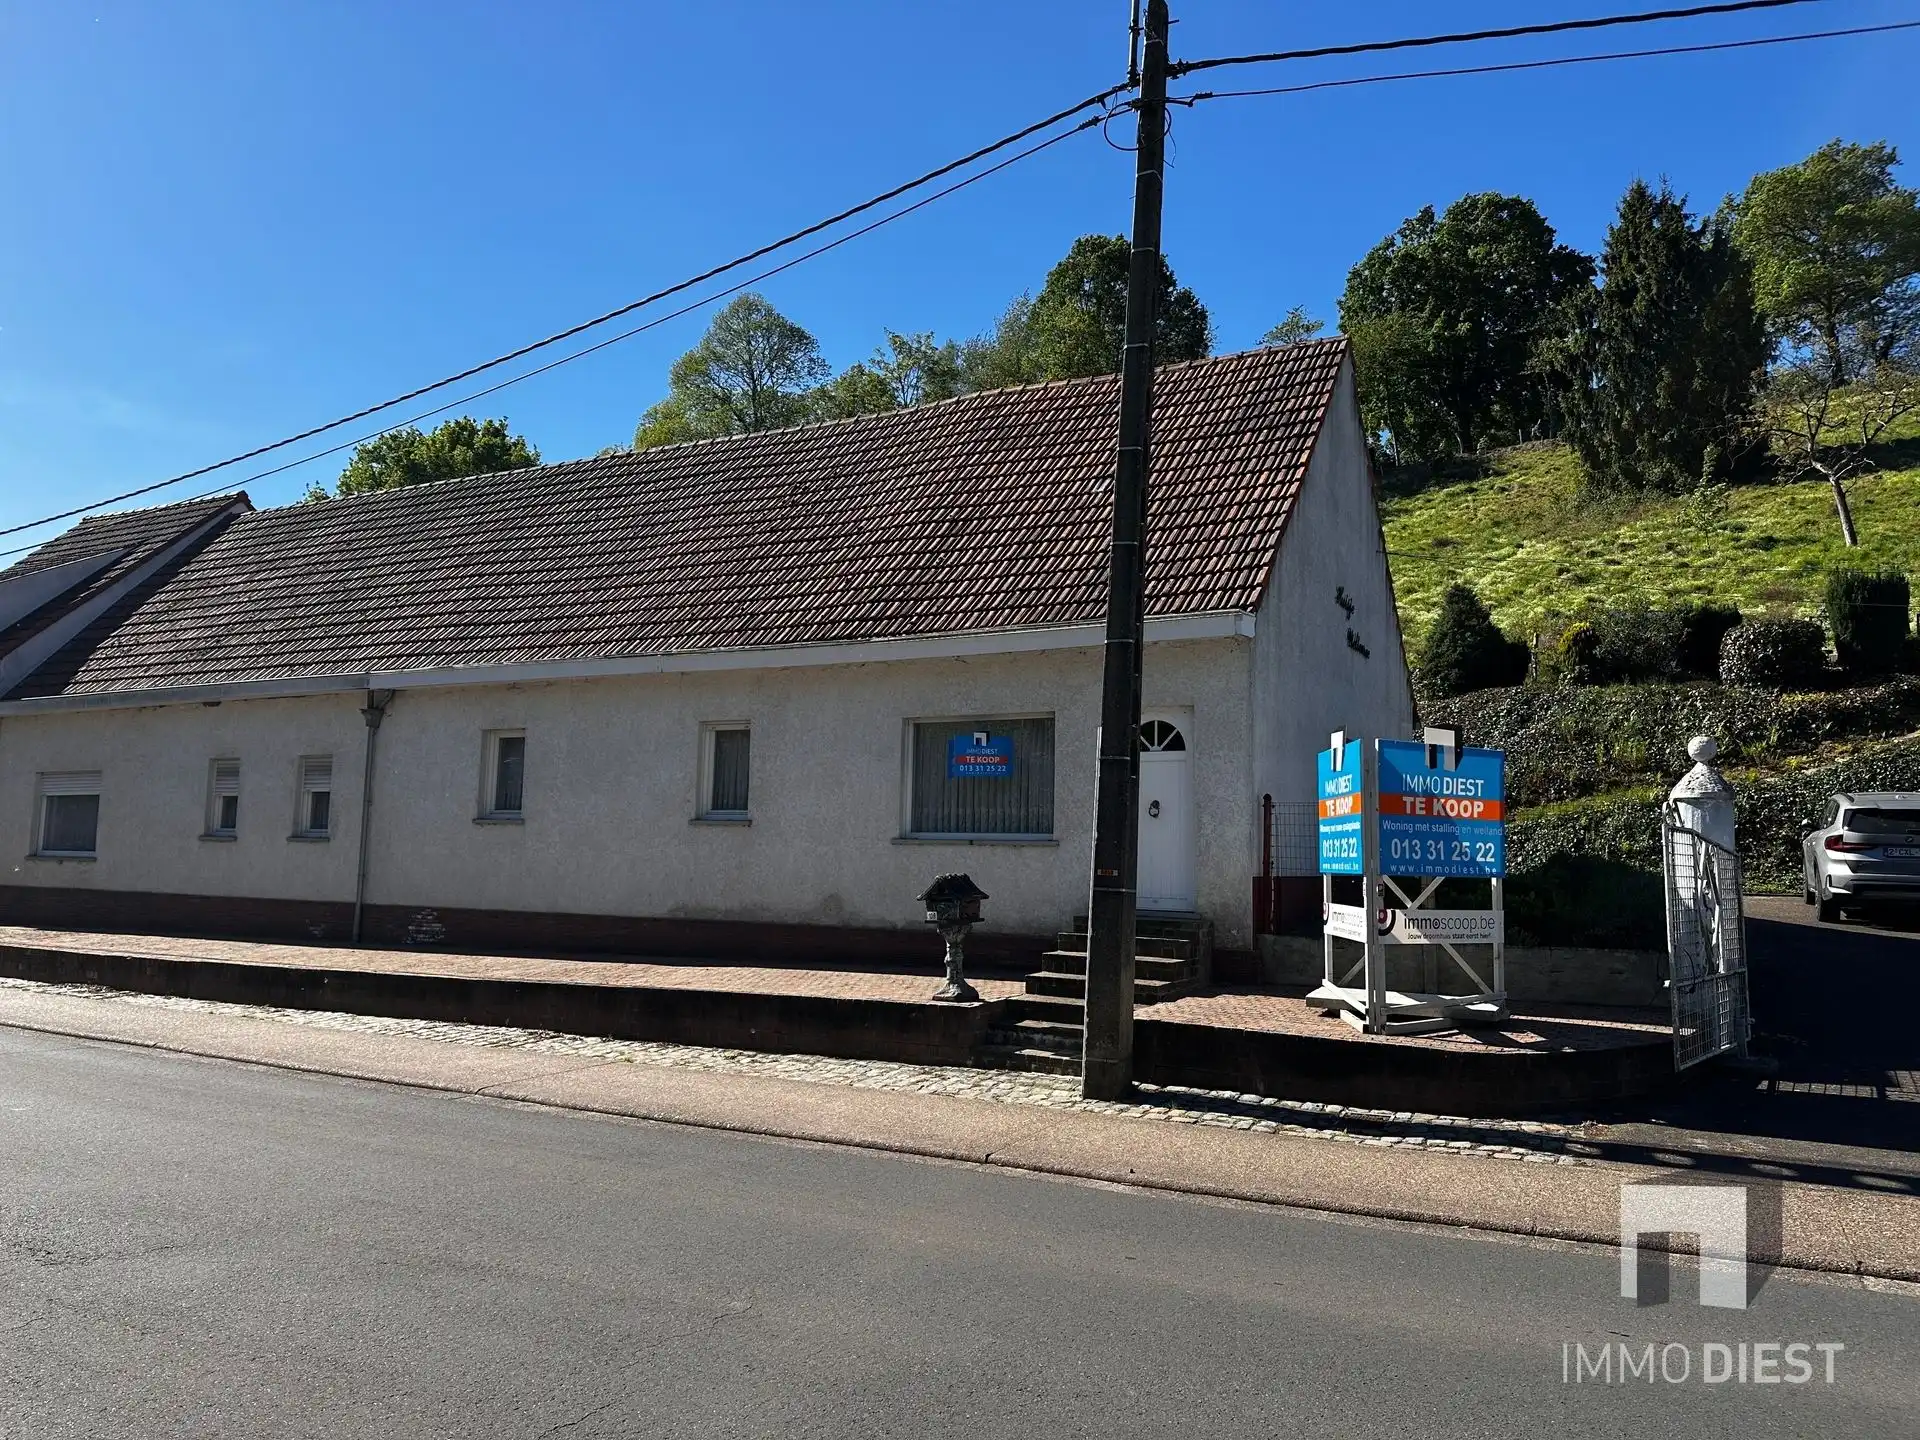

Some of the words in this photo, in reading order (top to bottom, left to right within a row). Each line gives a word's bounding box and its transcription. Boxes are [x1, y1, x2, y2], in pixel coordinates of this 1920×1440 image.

[977, 756, 1000, 764] KOOP
[1338, 774, 1353, 794] DIEST
[1402, 773, 1440, 794] IMMO
[1443, 777, 1484, 797] DIEST
[1325, 800, 1335, 816] TE
[1336, 796, 1353, 816] KOOP
[1402, 797, 1426, 815] TE
[1433, 798, 1484, 818] KOOP
[1382, 820, 1413, 833] Woning
[1415, 821, 1430, 831] met
[1432, 823, 1460, 835] stalling
[1462, 826, 1471, 834] en
[1474, 825, 1503, 836] weiland
[1323, 839, 1333, 857] 013
[1333, 838, 1341, 857] 31
[1341, 837, 1348, 857] 25
[1348, 837, 1357, 857] 22
[1391, 838, 1421, 860] 013
[1427, 839, 1445, 860] 31
[1451, 841, 1471, 861] 25
[1476, 842, 1495, 862] 22
[1390, 864, 1497, 875] www.immodiest.be
[1404, 913, 1495, 933] immoscoop.be
